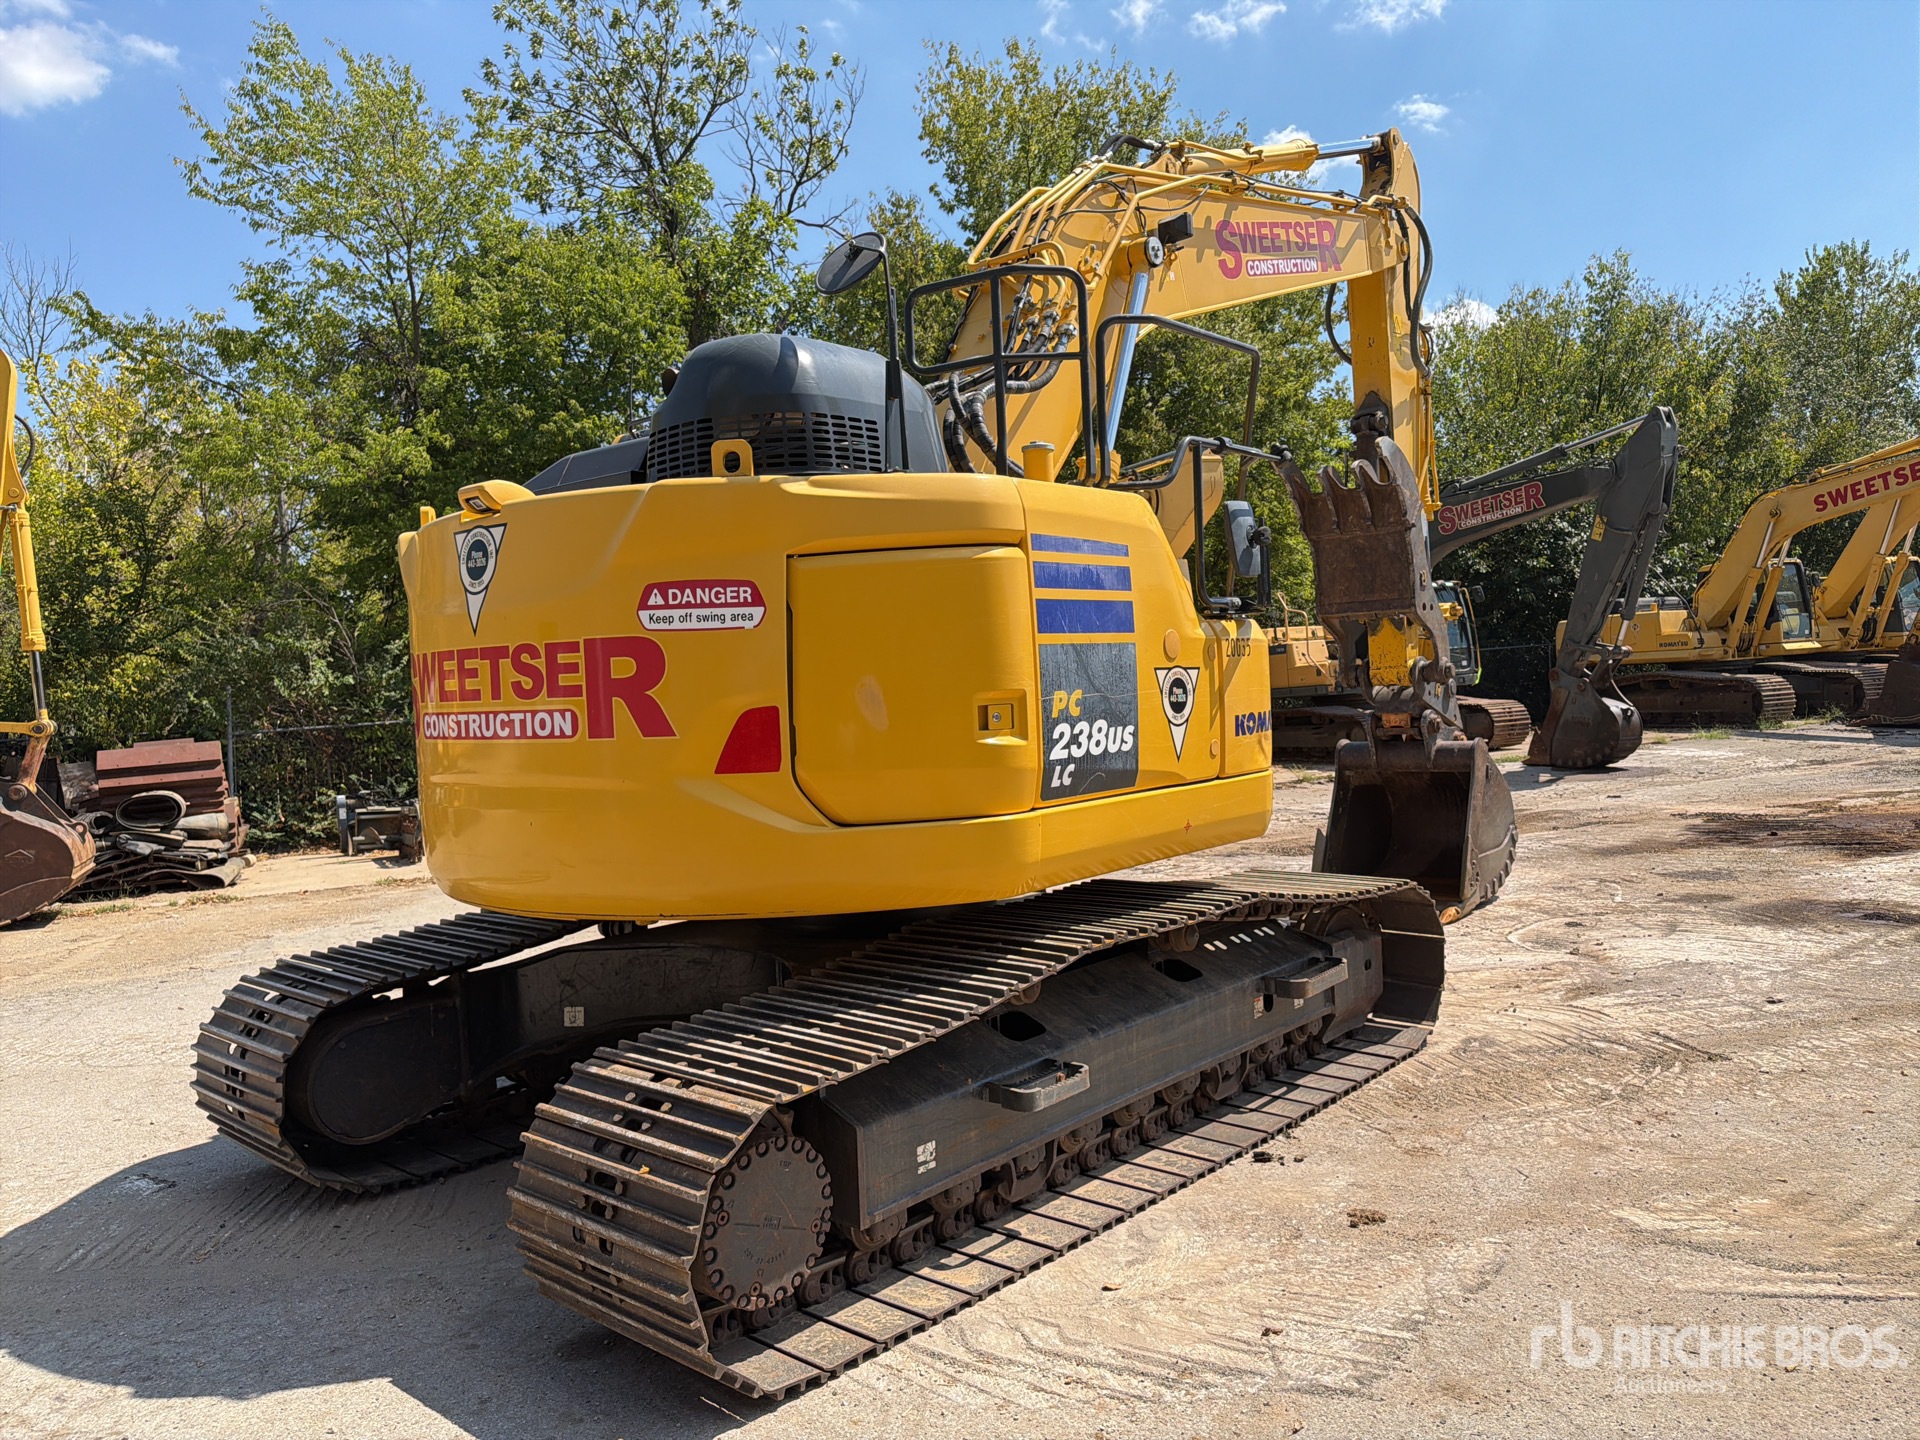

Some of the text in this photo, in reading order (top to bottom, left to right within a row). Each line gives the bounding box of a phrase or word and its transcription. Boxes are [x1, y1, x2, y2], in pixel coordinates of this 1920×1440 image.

[1215, 219, 1342, 280] SWEETSER
[1247, 257, 1318, 276] CONSTRUCTION
[1438, 481, 1546, 535] SWEETSER
[1460, 506, 1522, 528] CONSTRUCTION
[668, 587, 752, 605] DANGER
[648, 611, 754, 626] Keep off swing area
[1658, 640, 1689, 648] KOMATSU
[1051, 689, 1083, 718] PC
[424, 710, 573, 738] CONSTRUCTION
[1050, 763, 1076, 788] LC
